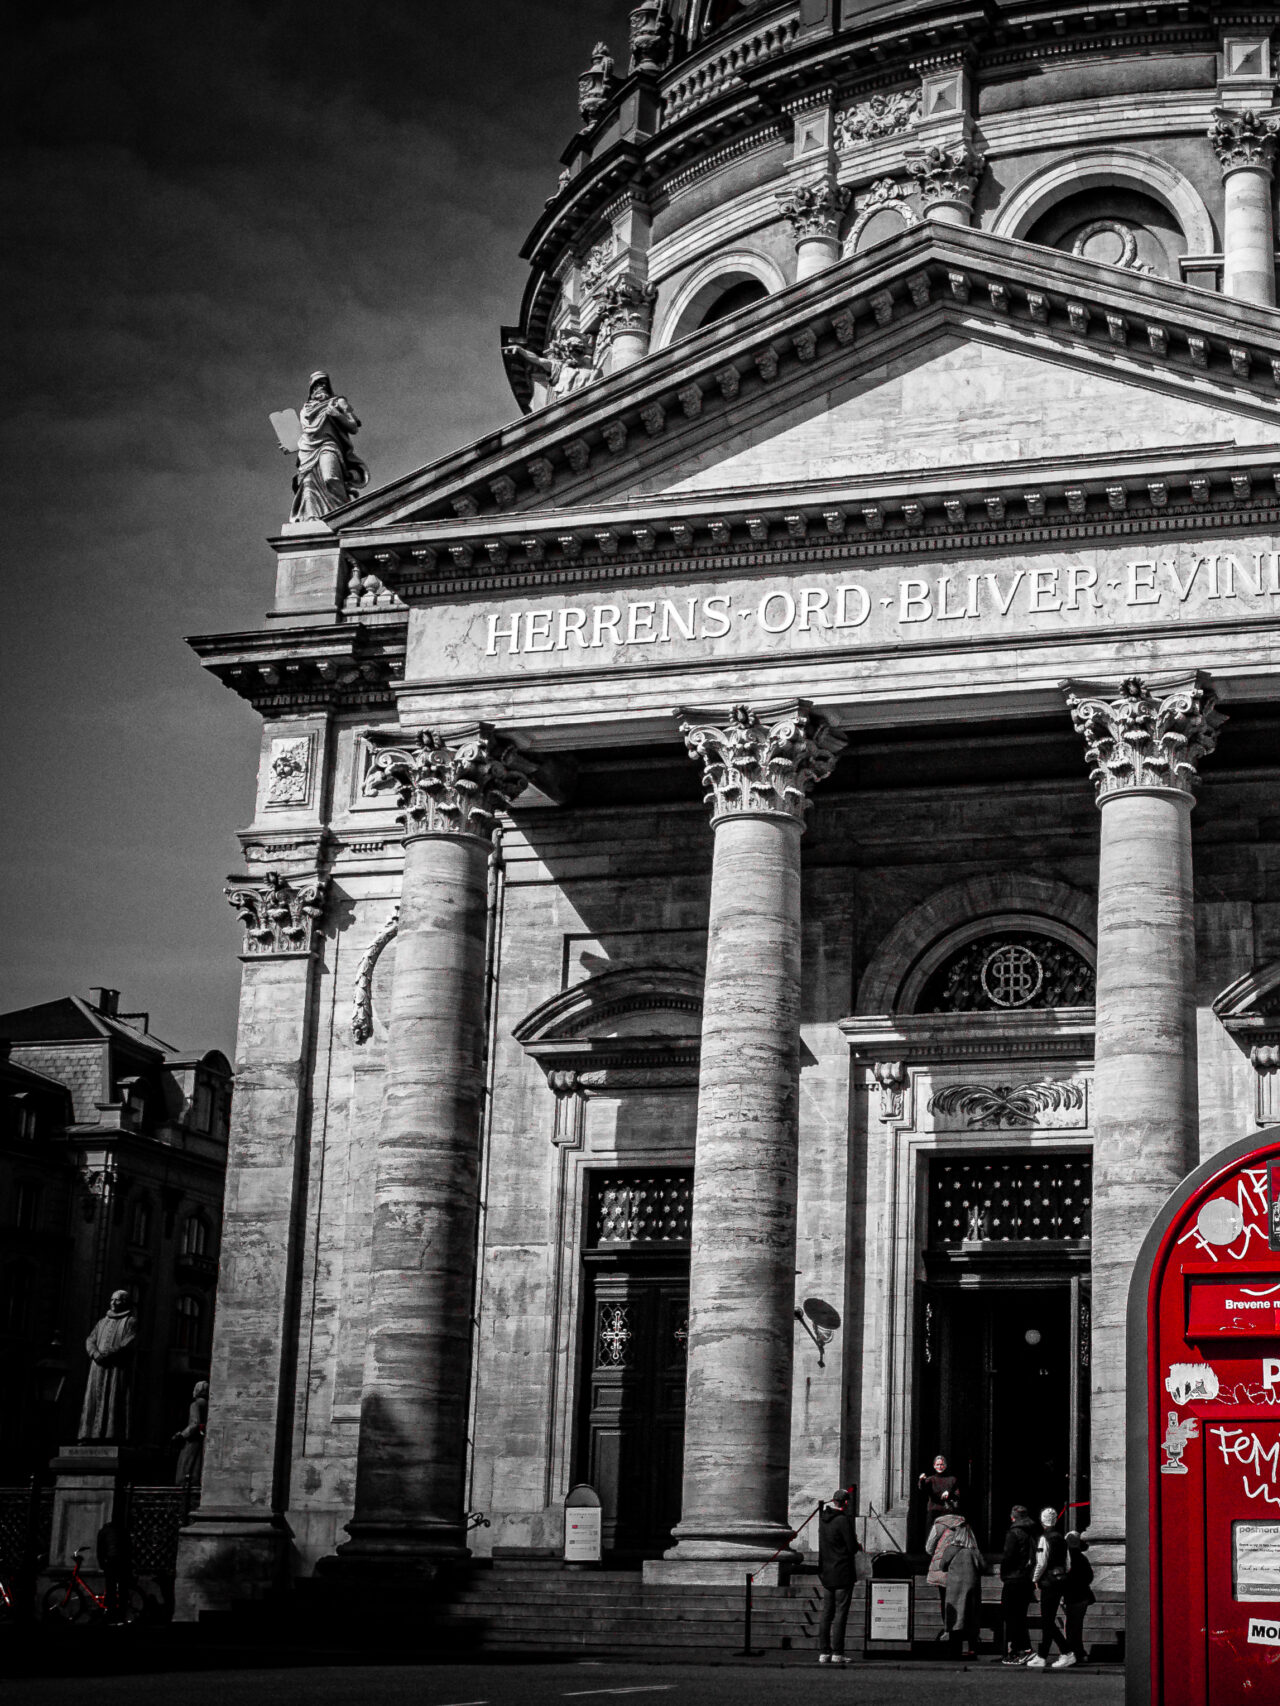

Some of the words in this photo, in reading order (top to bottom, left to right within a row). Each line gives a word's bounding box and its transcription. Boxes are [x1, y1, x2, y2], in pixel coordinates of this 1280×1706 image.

[485, 595, 732, 657] HERRENS
[757, 584, 872, 634] ORD
[898, 566, 1103, 624] BLIVER
[1225, 1299, 1271, 1310] Brevene
